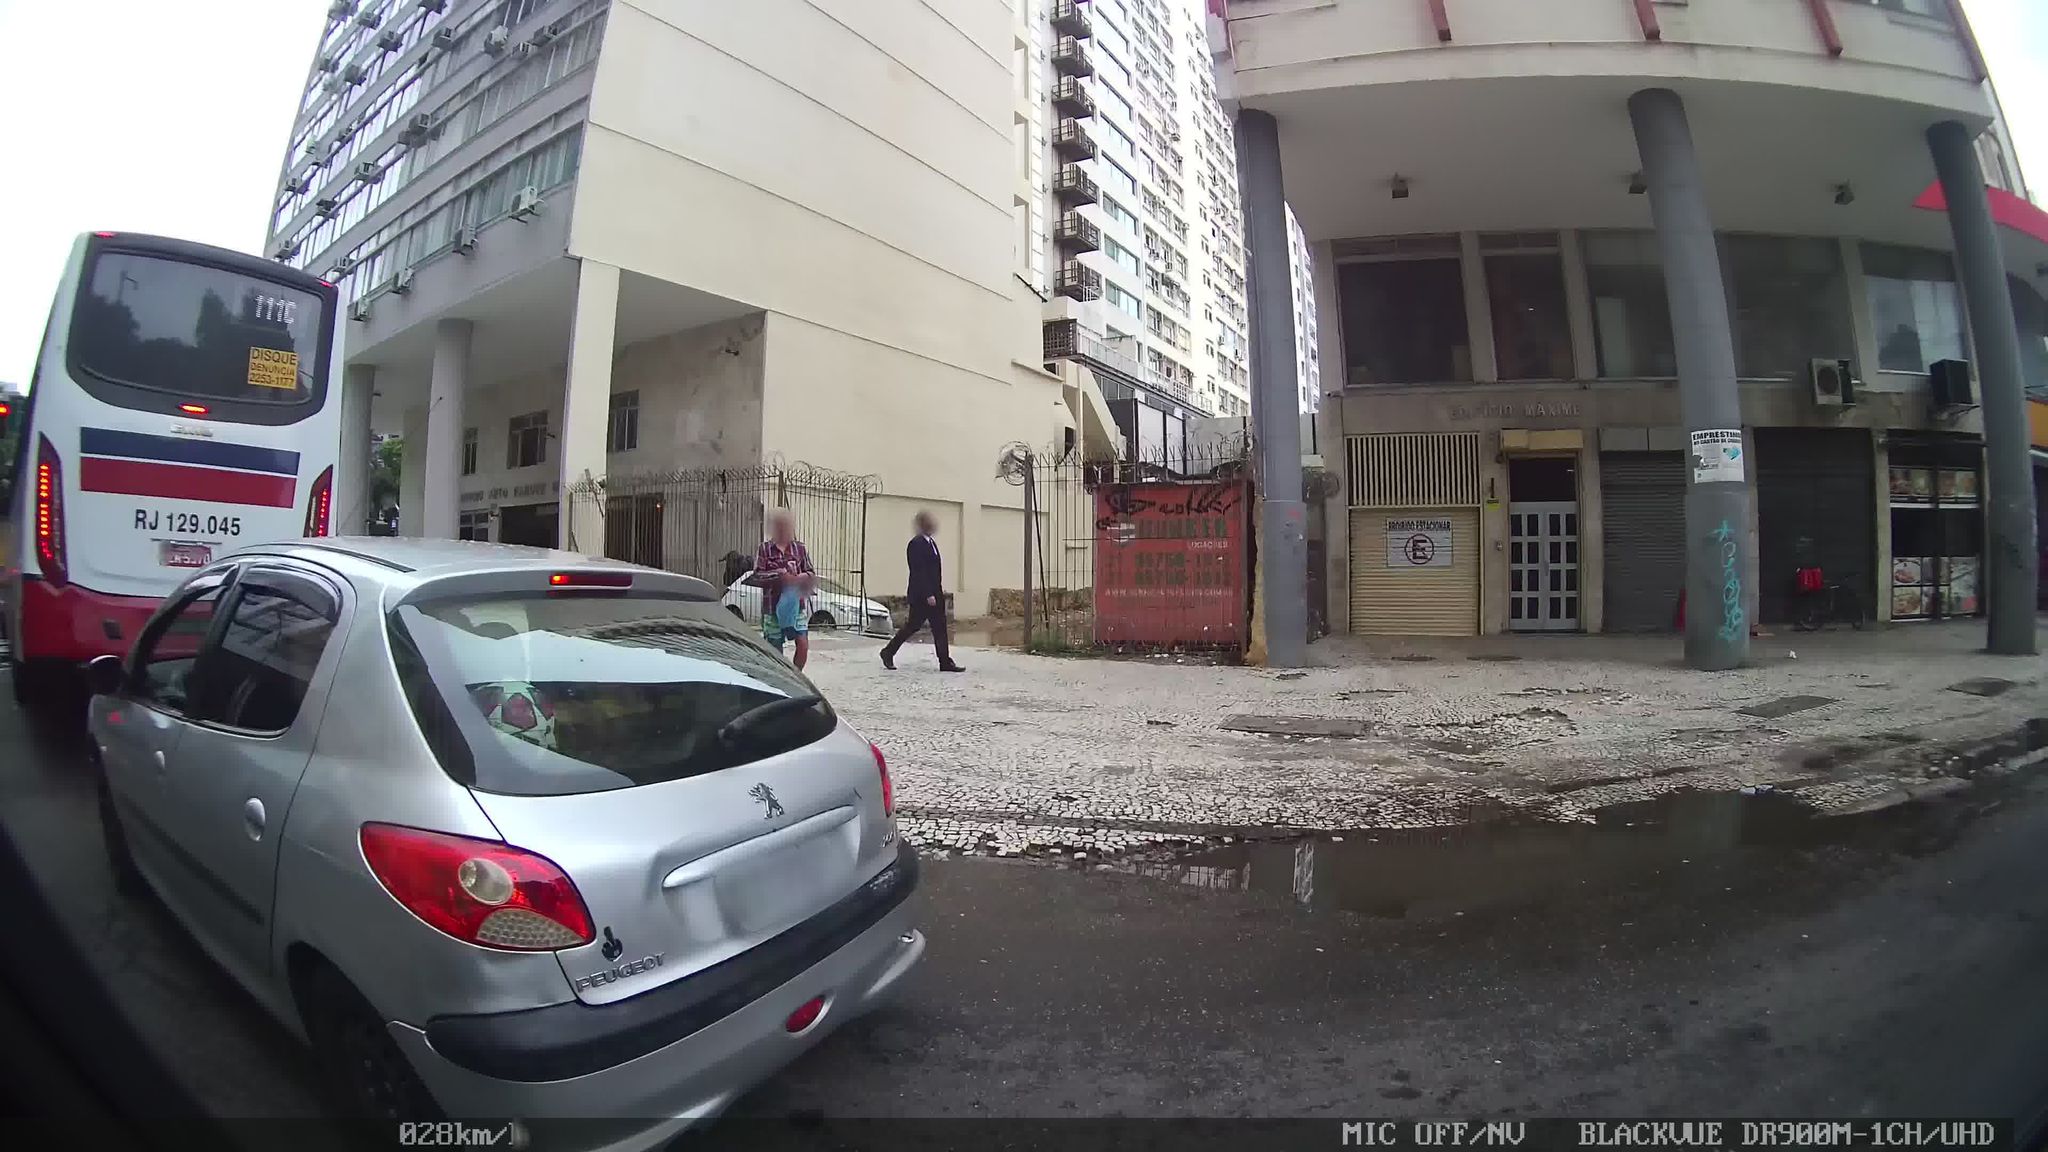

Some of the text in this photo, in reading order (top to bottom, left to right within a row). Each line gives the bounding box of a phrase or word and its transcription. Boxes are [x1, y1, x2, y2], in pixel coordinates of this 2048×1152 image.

[255, 295, 297, 324] 111C
[252, 348, 297, 365] DISQUE
[134, 508, 241, 536] RJ 129.045
[575, 951, 665, 993] PEUGEOT
